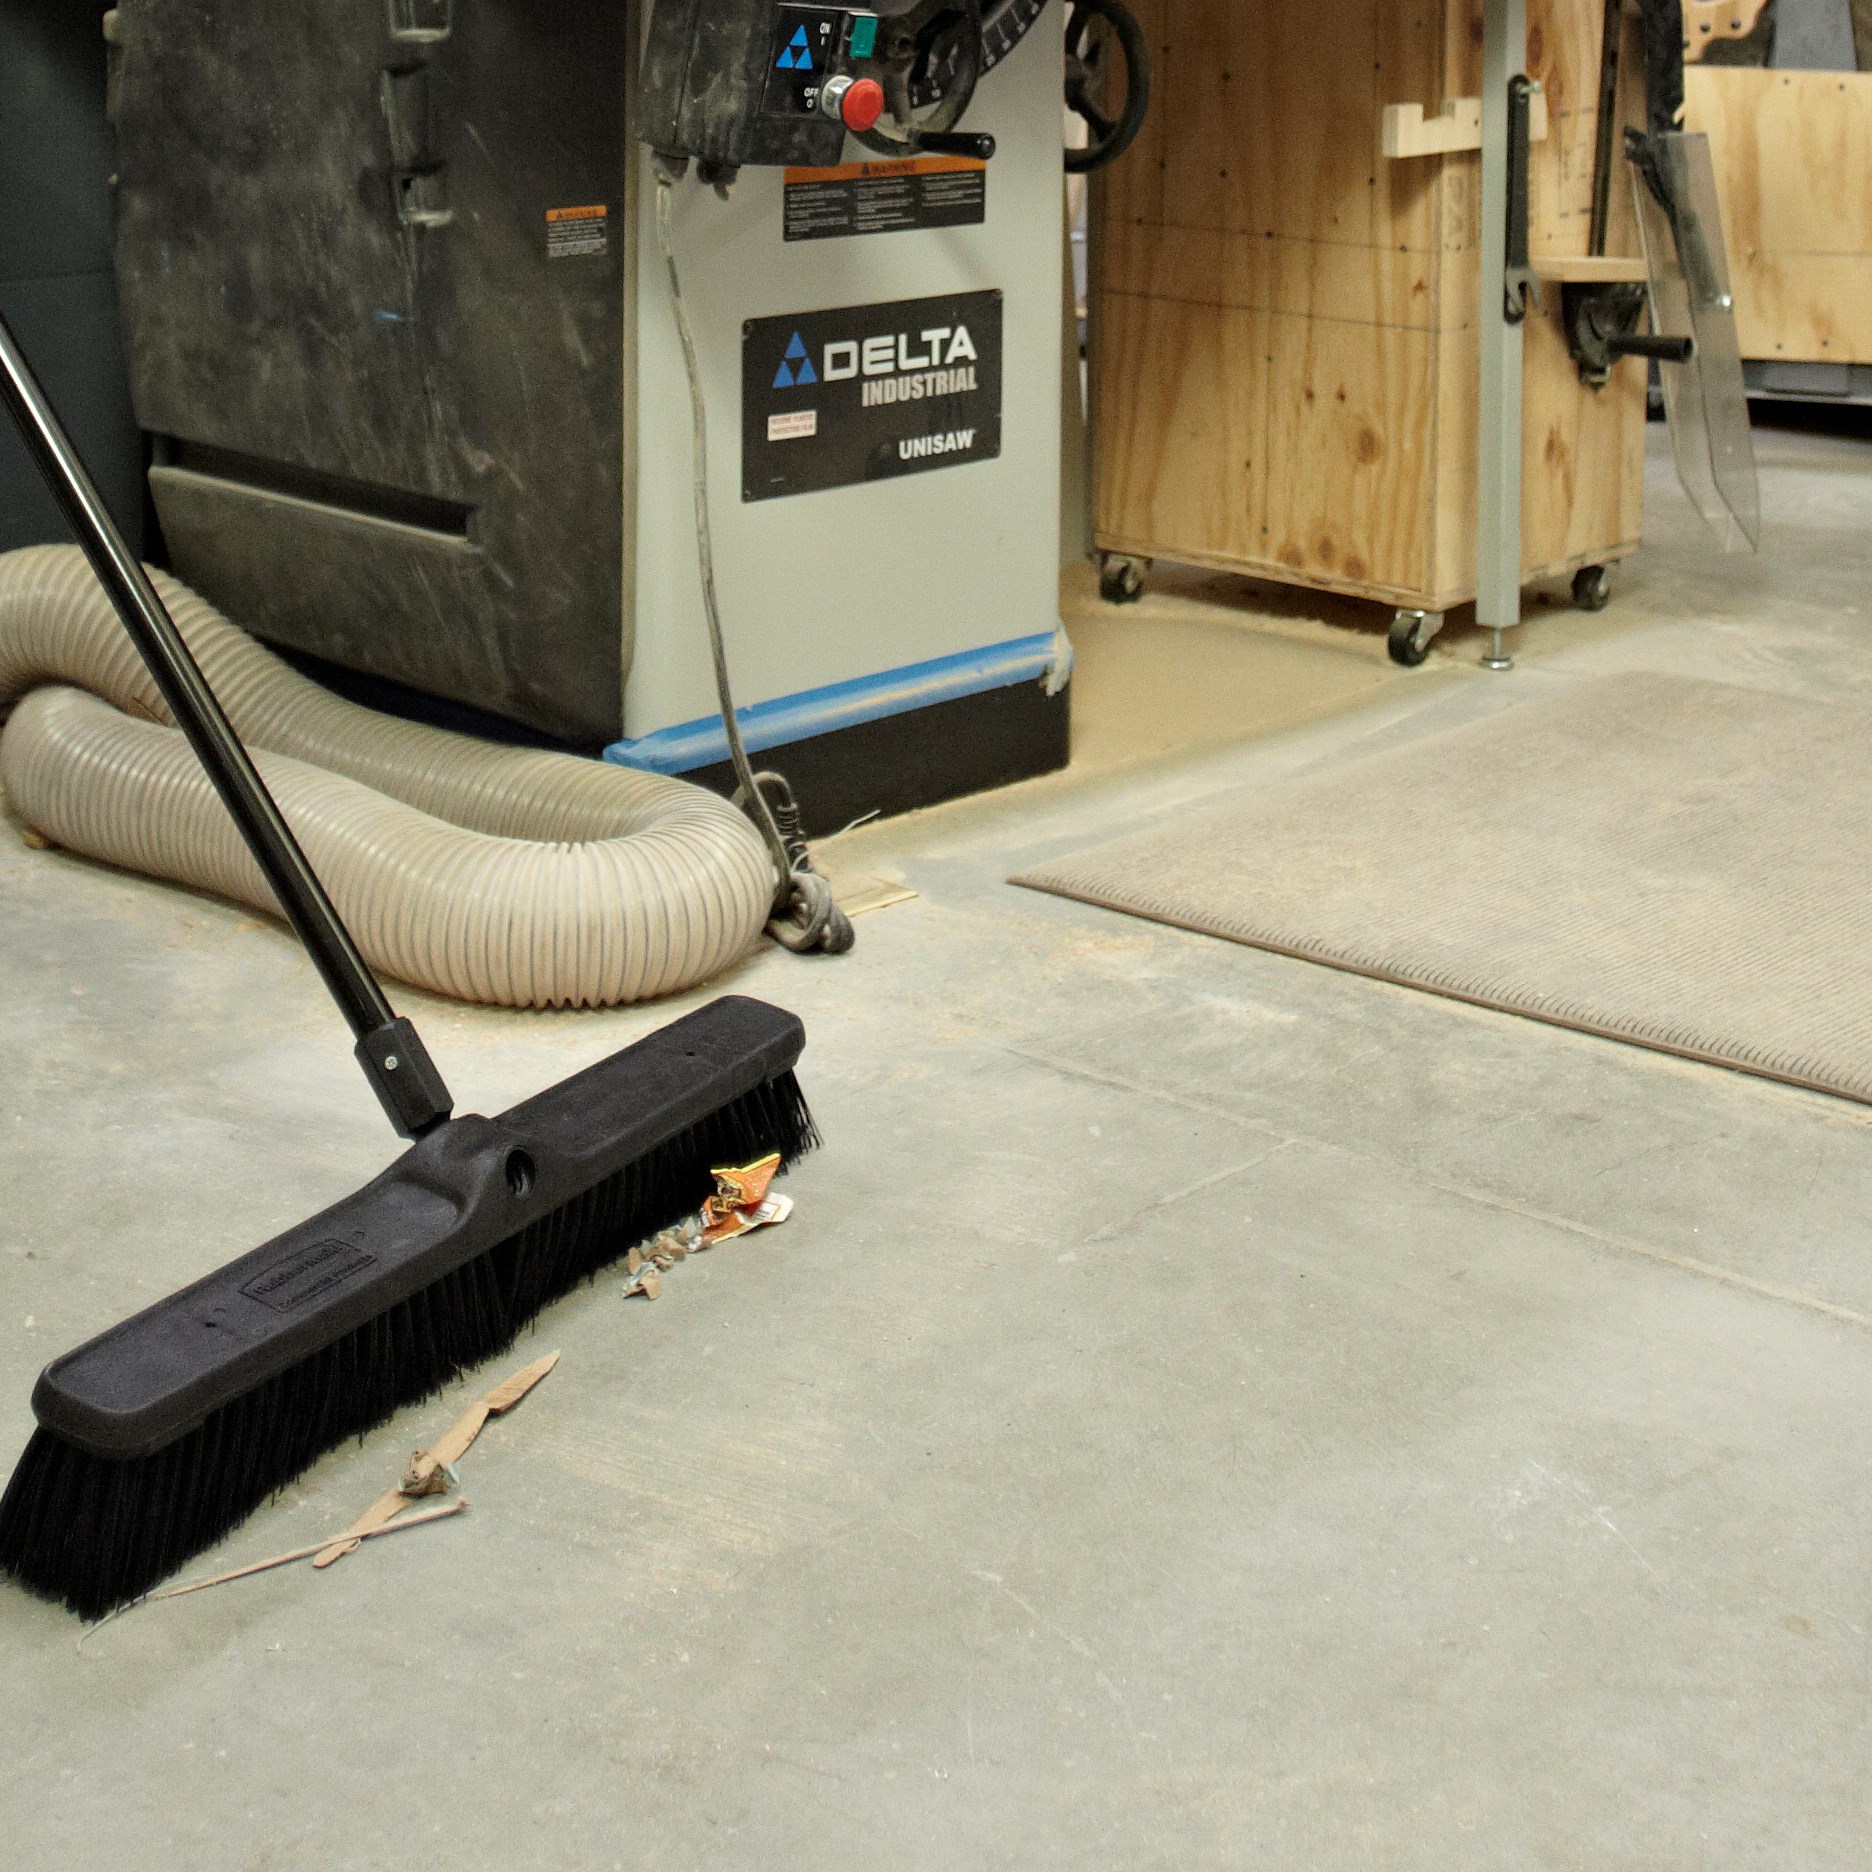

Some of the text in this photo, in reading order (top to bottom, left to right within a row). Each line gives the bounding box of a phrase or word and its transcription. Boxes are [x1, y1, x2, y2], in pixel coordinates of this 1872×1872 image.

[819, 21, 832, 35] ON
[803, 87, 820, 98] OFF
[822, 325, 977, 383] DELTA
[861, 367, 978, 407] INDUSTRIAL
[898, 430, 975, 461] UNISAW
